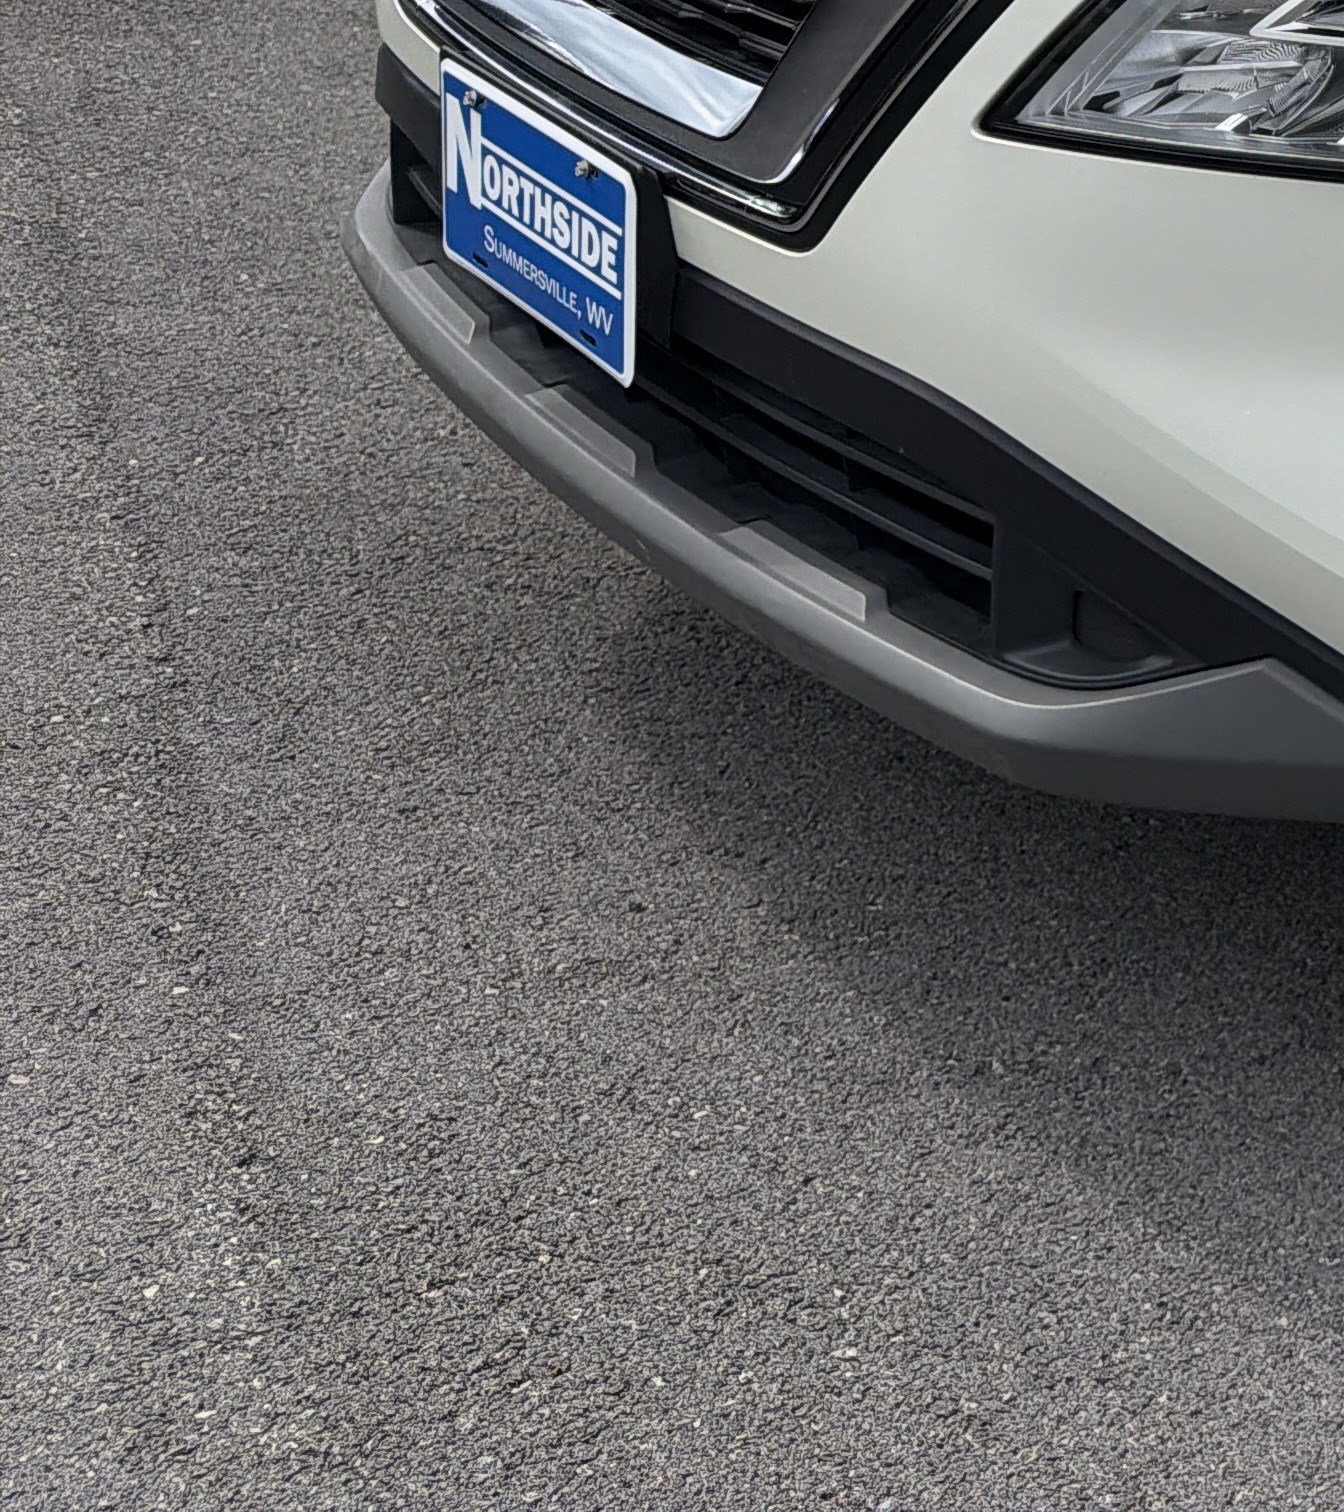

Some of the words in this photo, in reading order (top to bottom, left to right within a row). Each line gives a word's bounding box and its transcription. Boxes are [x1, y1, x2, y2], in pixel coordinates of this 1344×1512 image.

[446, 91, 619, 286] NORTHSIDE
[483, 225, 583, 321] SUMMERSVILLE,
[585, 296, 614, 337] WV
